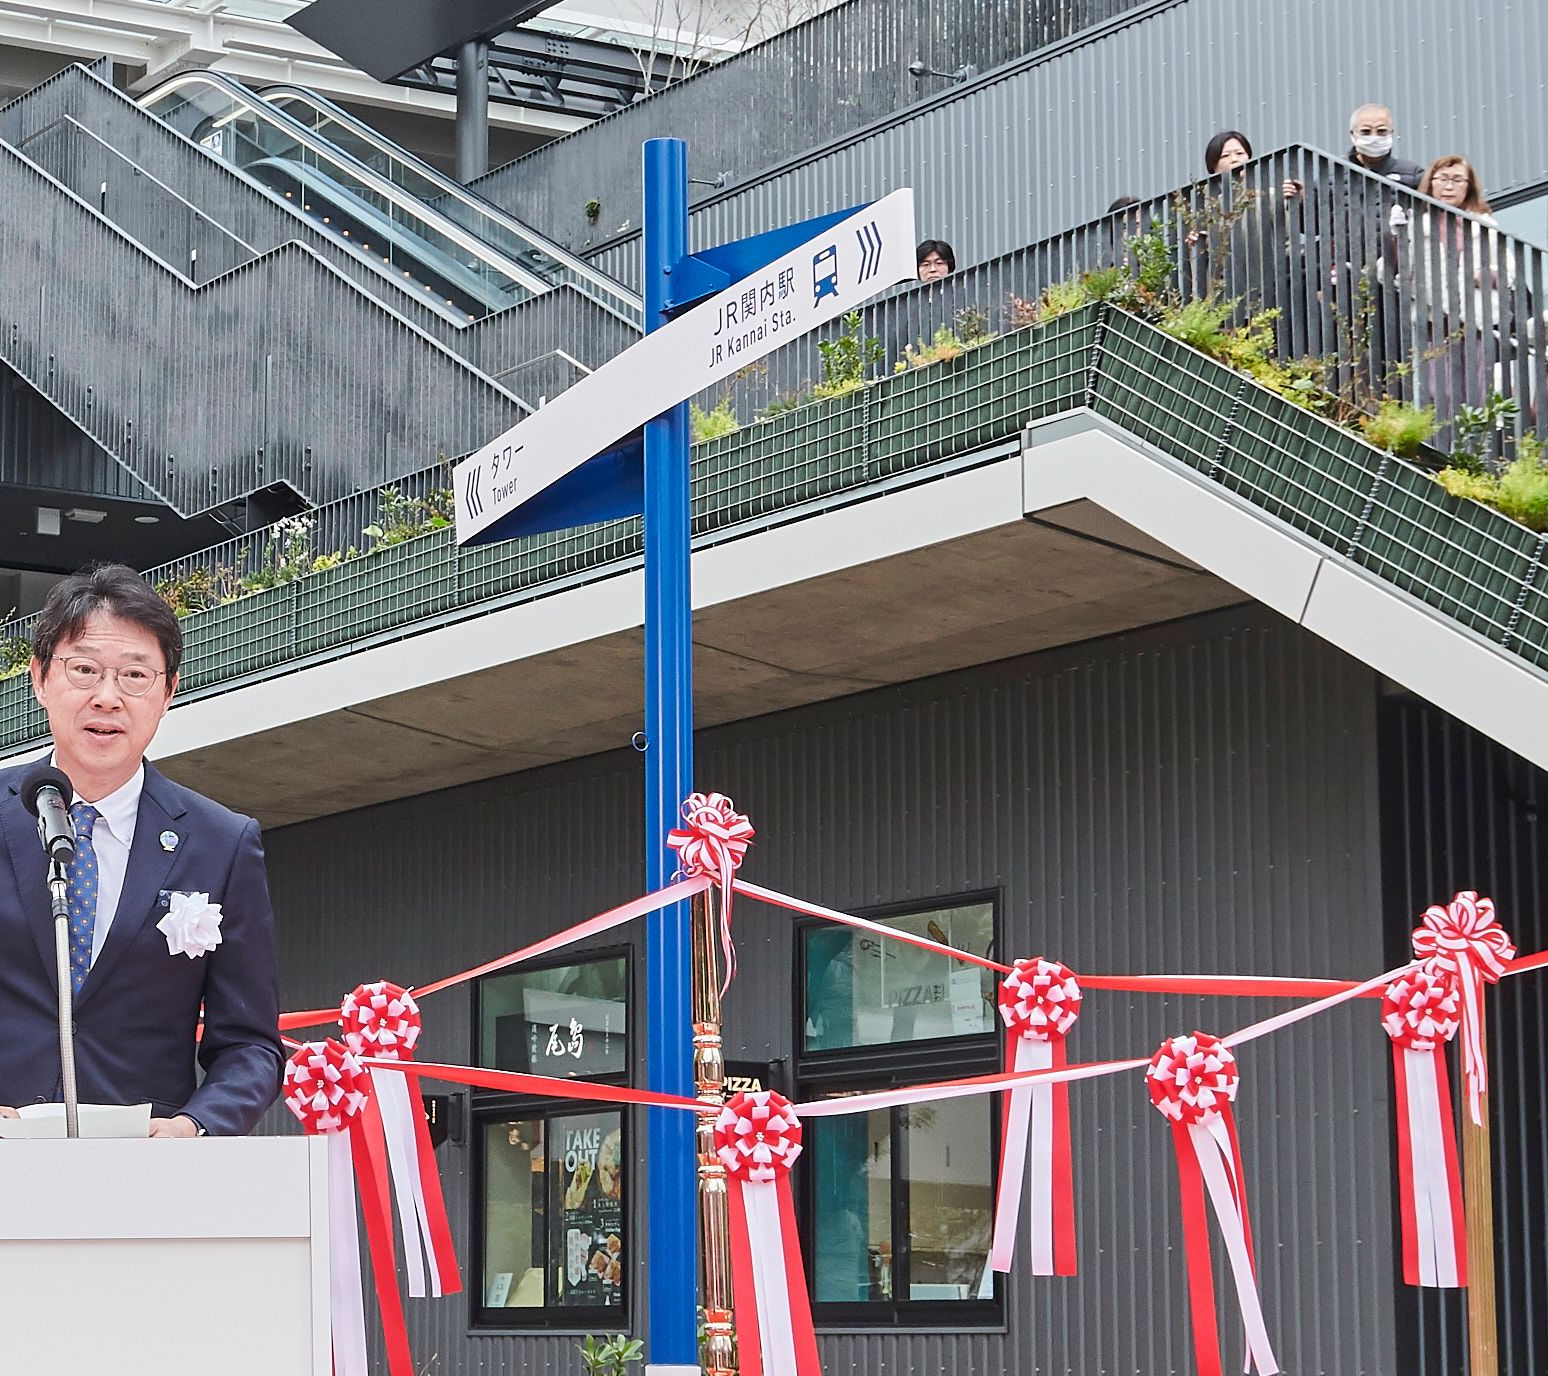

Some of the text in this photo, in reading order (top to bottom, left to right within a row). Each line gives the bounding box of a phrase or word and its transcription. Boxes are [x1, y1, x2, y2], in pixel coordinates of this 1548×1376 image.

[714, 266, 795, 335] JR関内駅
[709, 310, 796, 368] JR Kannai Sta.
[491, 445, 524, 479] タワー
[492, 478, 517, 505] Tower
[722, 1077, 762, 1092] PIZZA
[566, 1128, 601, 1150] TAKE
[565, 1149, 598, 1172] OUT
